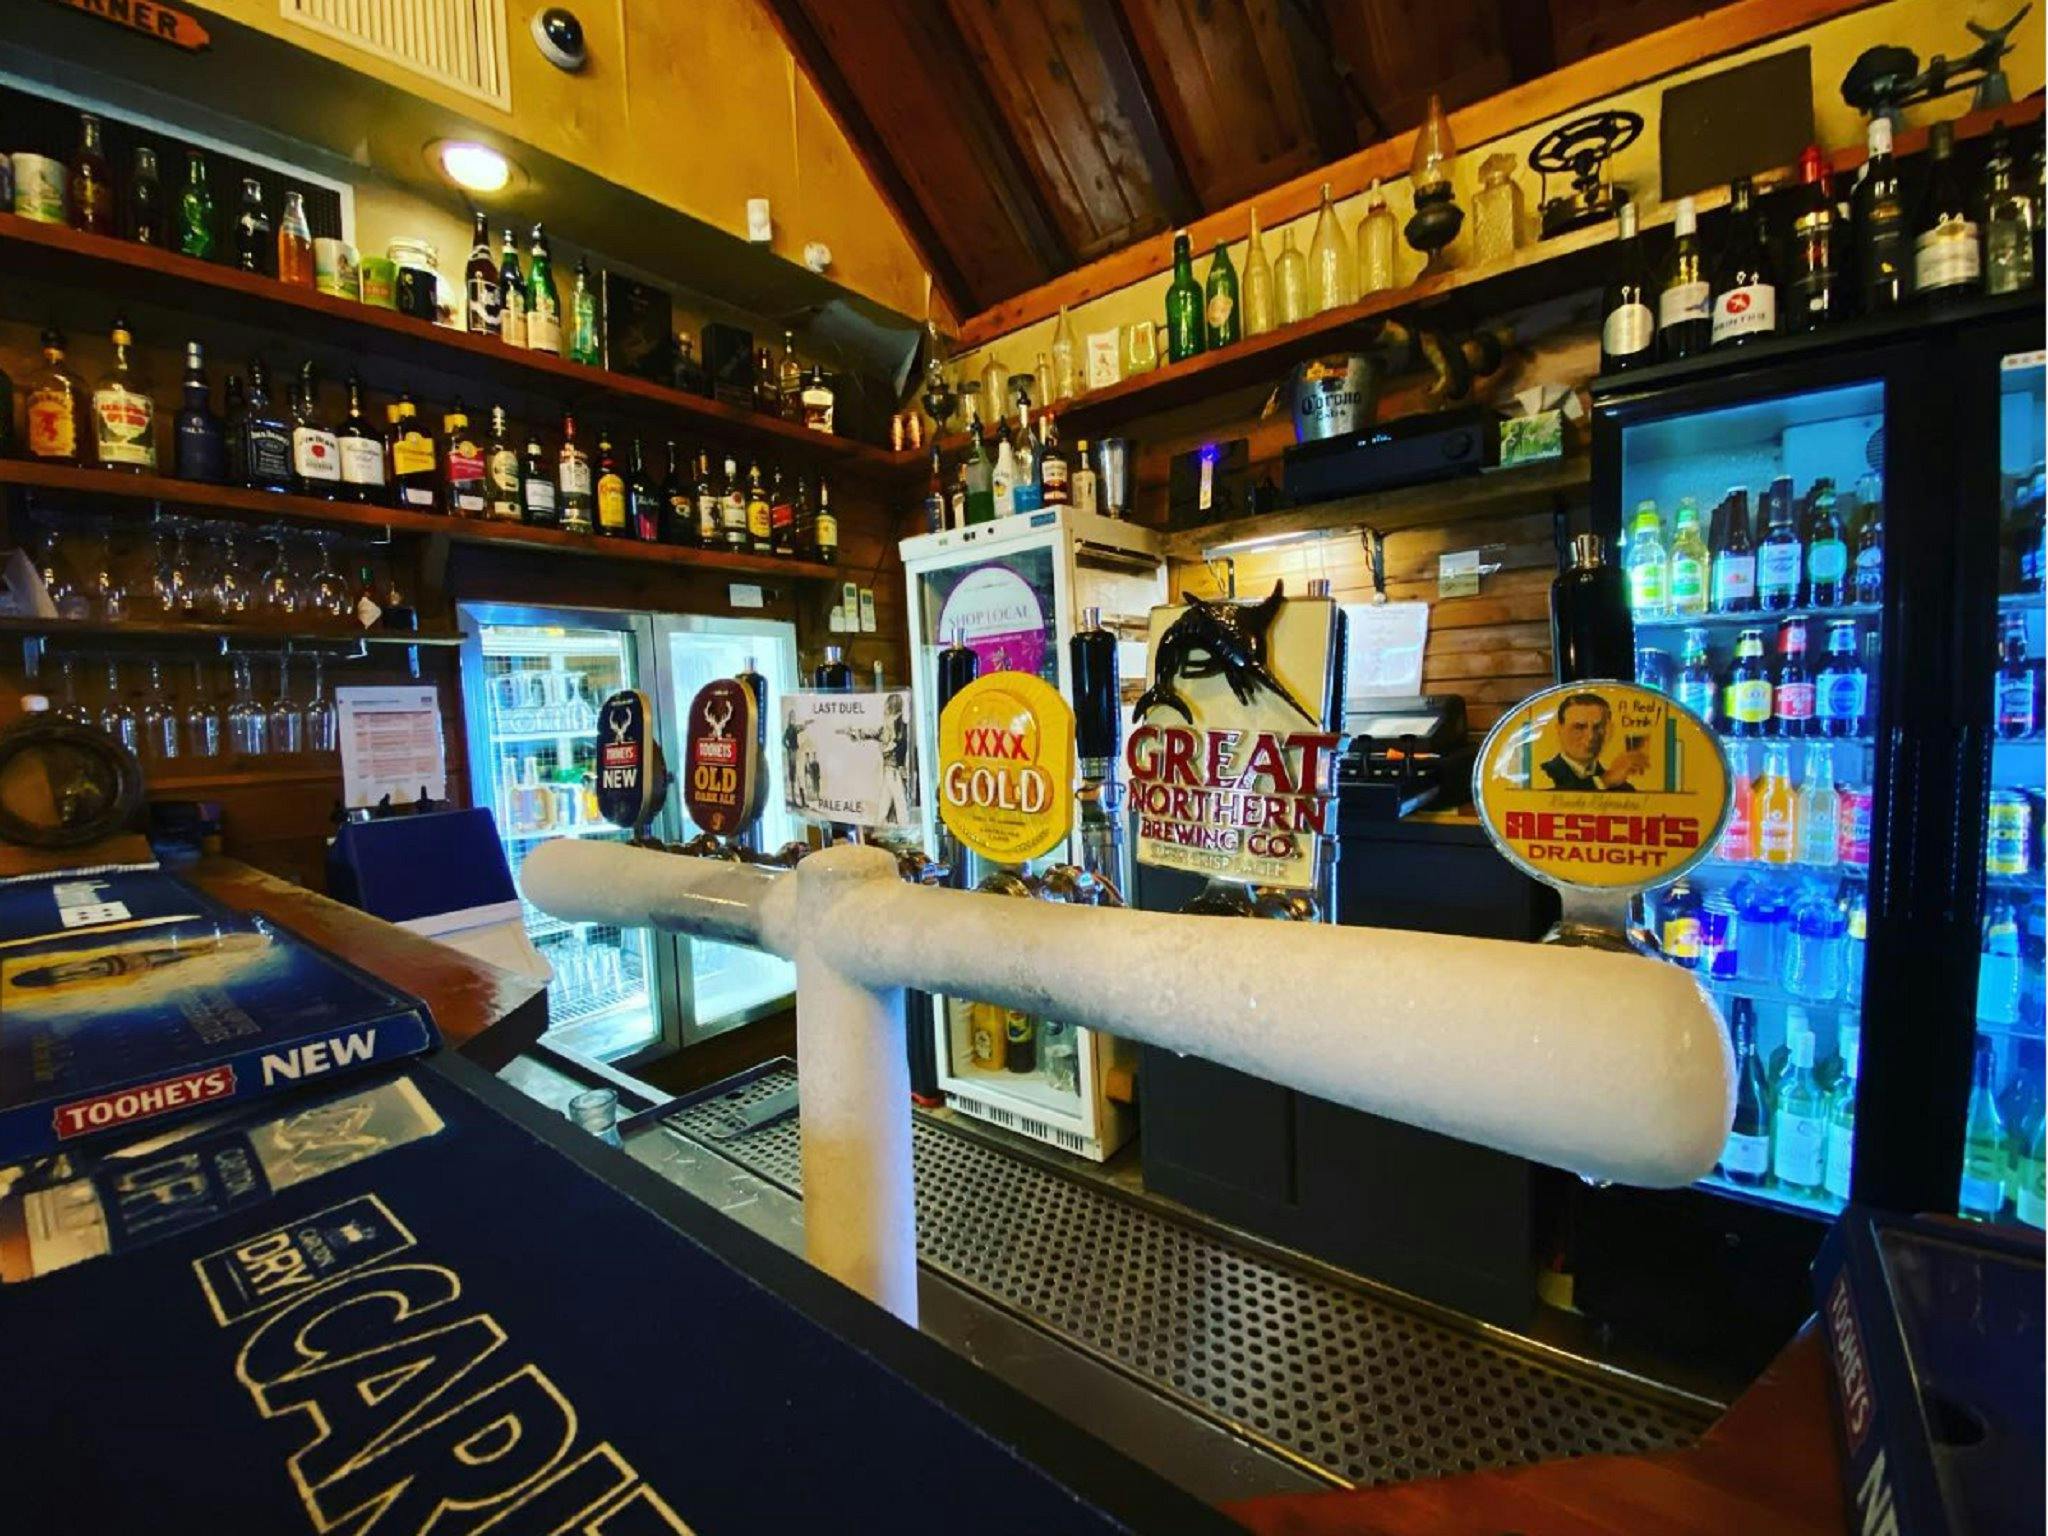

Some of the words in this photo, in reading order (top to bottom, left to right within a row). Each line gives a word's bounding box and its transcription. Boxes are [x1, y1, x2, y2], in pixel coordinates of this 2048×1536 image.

[813, 702, 837, 714] LAST
[839, 702, 866, 715] DUEL
[964, 728, 1031, 761] XXXX
[1127, 724, 1340, 795] GREAT
[602, 768, 637, 789] NEW
[694, 765, 737, 794] OLD
[944, 761, 1046, 814] GOLD
[695, 791, 719, 803] DARK
[719, 792, 736, 806] ALE
[818, 799, 841, 812] PALE
[842, 801, 864, 813] ALE
[1128, 779, 1329, 834] NORTHERN
[1140, 816, 1238, 853] BREWING
[1248, 834, 1304, 860] CO.
[1528, 844, 1668, 867] DRAUGHT
[66, 1069, 226, 1130] TOOHEYS
[261, 1029, 376, 1087] NEW
[237, 1233, 315, 1295] DRY
